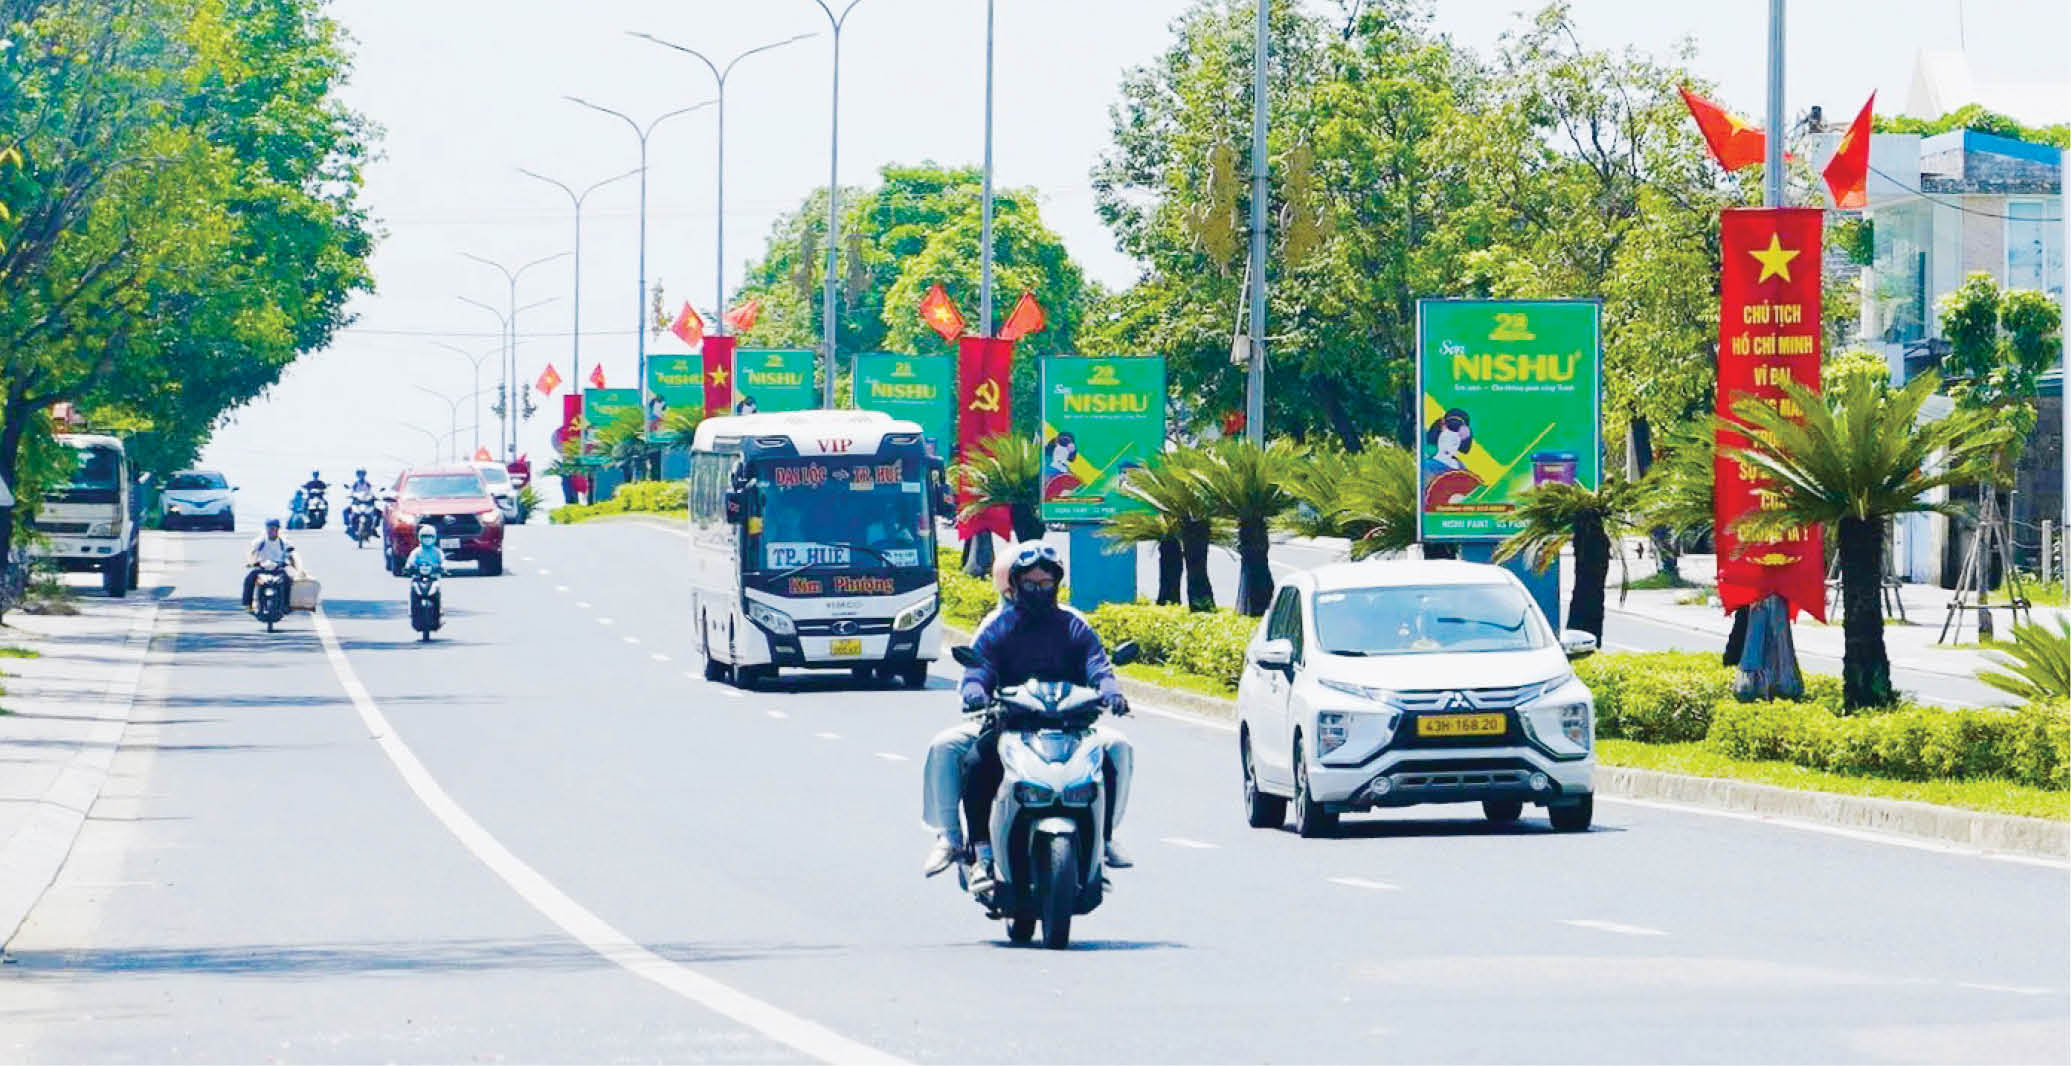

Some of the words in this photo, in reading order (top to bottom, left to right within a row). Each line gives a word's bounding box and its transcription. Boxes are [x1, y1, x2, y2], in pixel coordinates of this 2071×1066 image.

[1743, 299, 1770, 324] CHỦ
[1774, 303, 1801, 327] TỊCH
[1753, 332, 1776, 355] CHÍ
[1778, 335, 1813, 354] MINH
[1453, 353, 1575, 381] NISHU
[1063, 392, 1149, 413] NISHU
[817, 438, 853, 454] VIP
